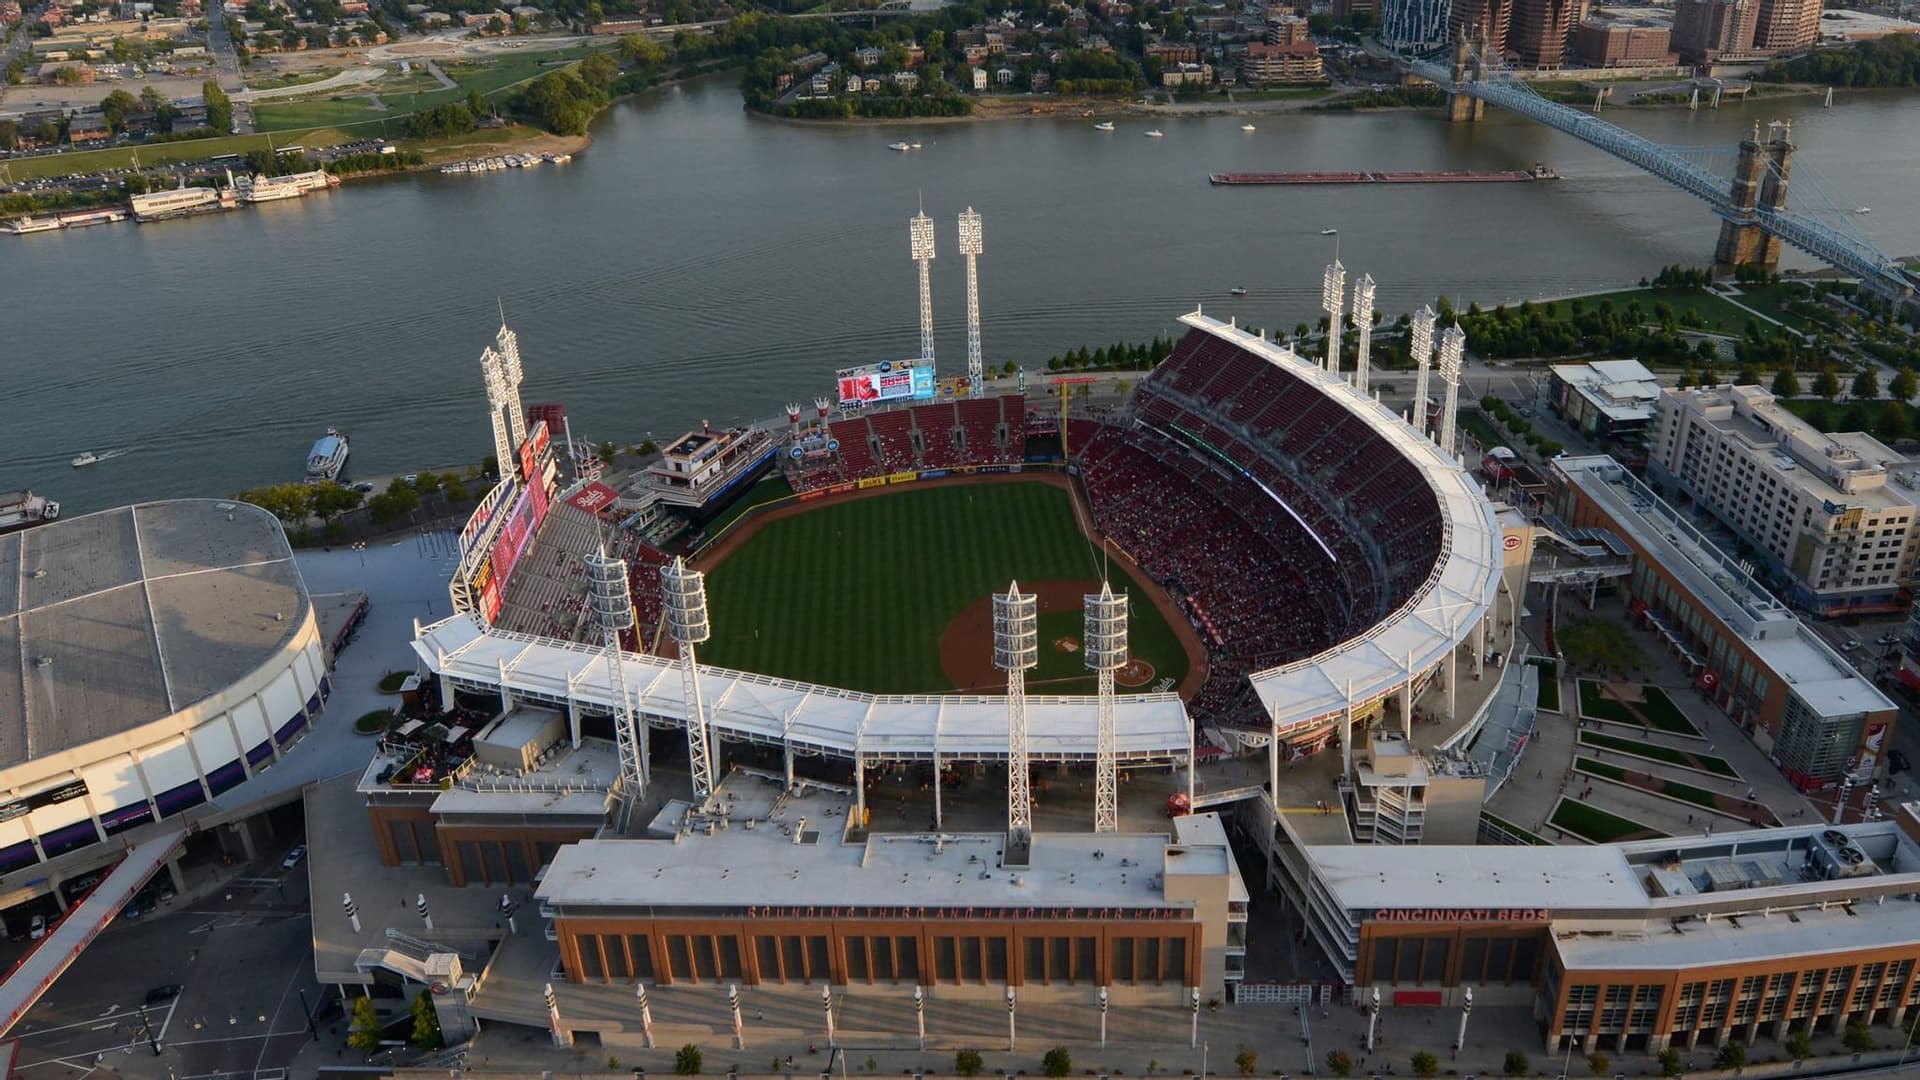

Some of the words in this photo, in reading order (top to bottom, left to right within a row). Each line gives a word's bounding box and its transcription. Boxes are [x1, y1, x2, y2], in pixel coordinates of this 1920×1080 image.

[866, 905, 925, 920] THIRD
[936, 905, 973, 920] AND
[984, 906, 1075, 920] HEADING
[1085, 906, 1123, 920] FOR
[1134, 907, 1188, 920] HOME
[1375, 908, 1491, 921] CINCINNATI
[1497, 908, 1549, 921] REDS
